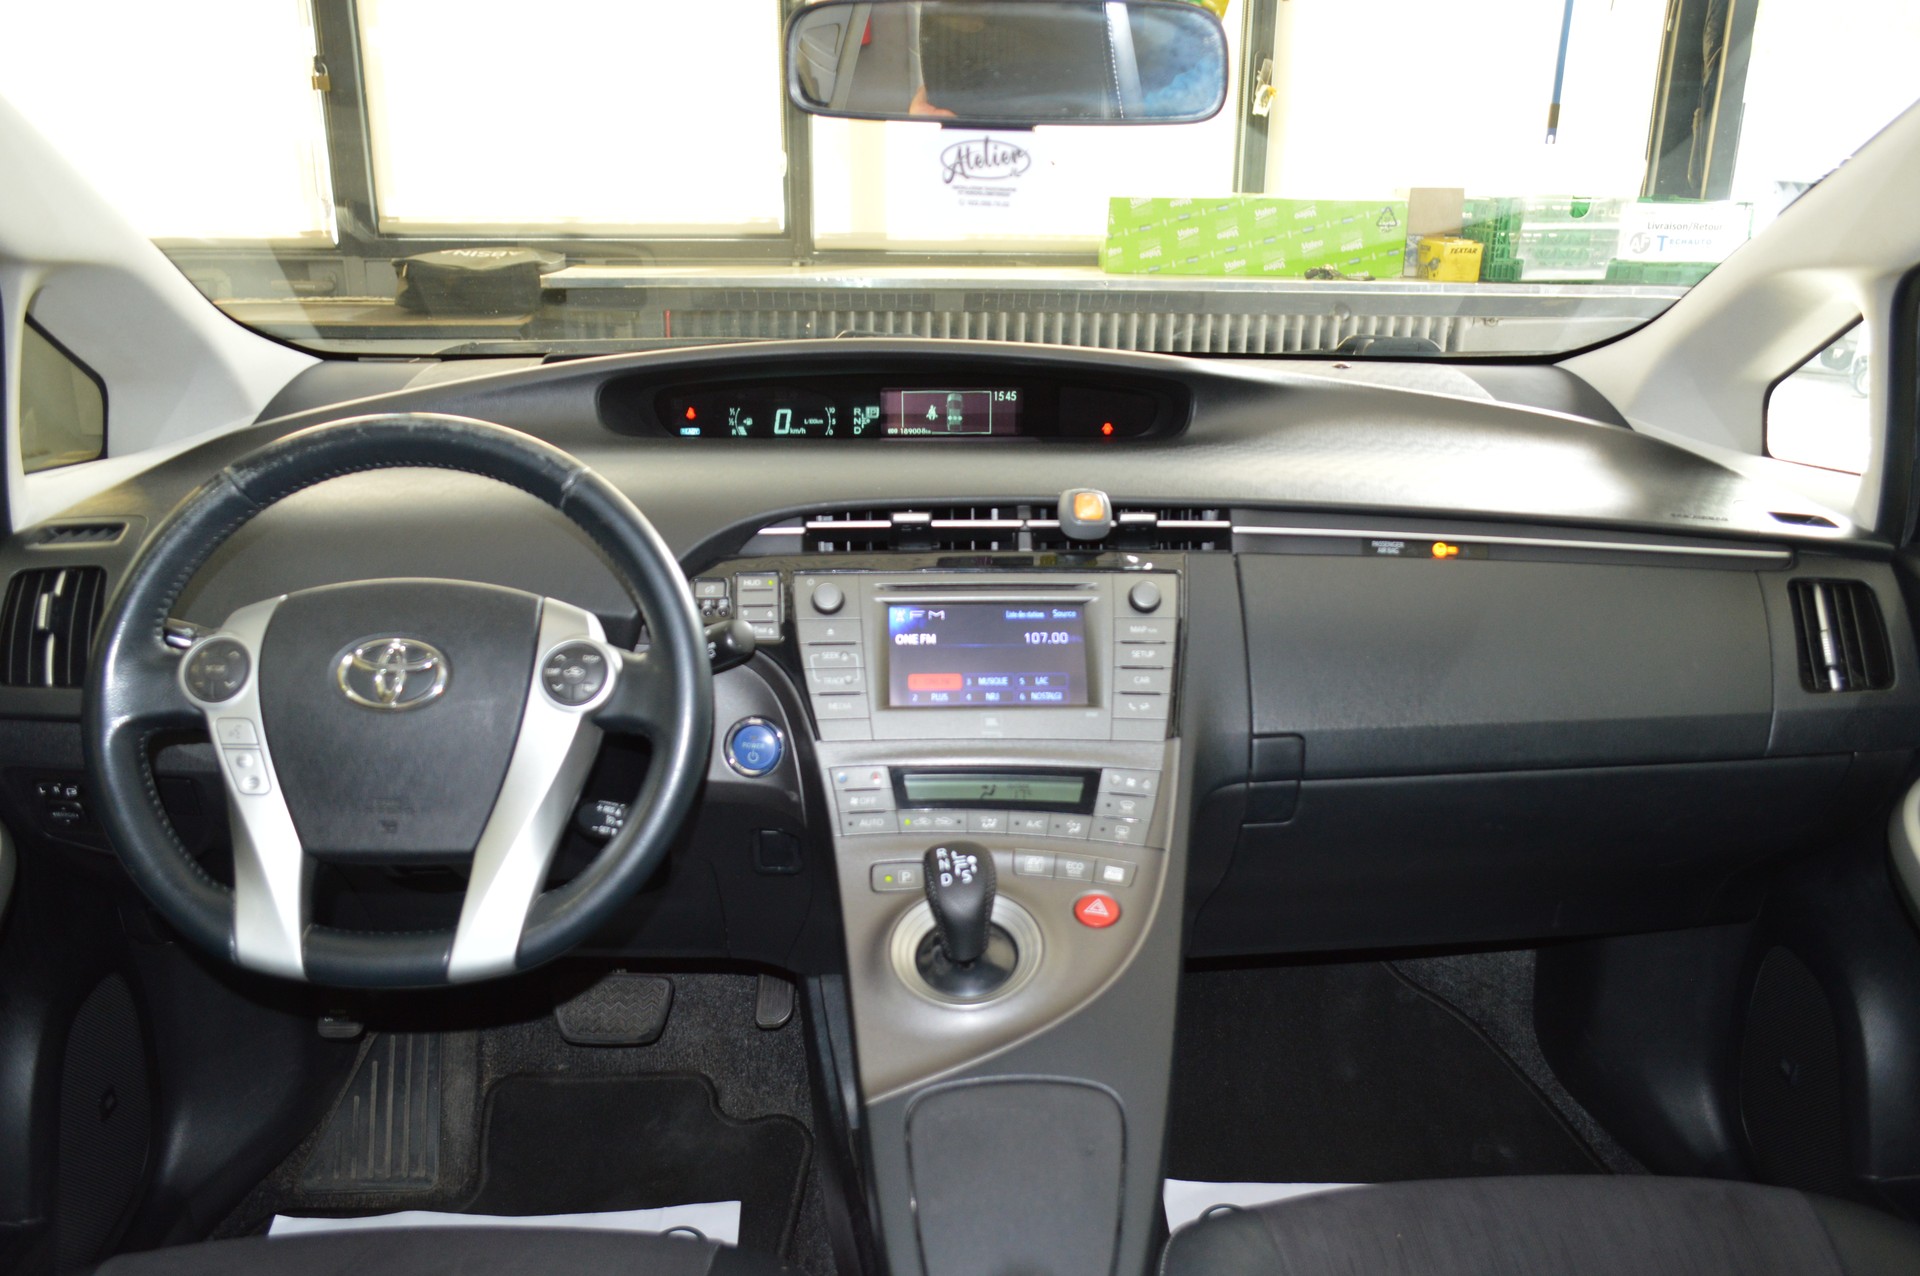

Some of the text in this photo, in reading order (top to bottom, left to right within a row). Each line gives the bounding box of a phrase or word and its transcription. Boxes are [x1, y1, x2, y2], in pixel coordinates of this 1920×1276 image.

[853, 406, 862, 416] R
[774, 408, 793, 435] 0
[853, 417, 862, 426] N
[853, 427, 862, 436] D
[1052, 609, 1078, 619] Source
[895, 633, 937, 646] ONE FM
[1024, 631, 1070, 645] 107.00
[1131, 650, 1156, 658] SETUP
[858, 817, 884, 826] AUTO
[936, 847, 948, 859] R
[938, 857, 951, 872] N
[940, 872, 953, 888] D
